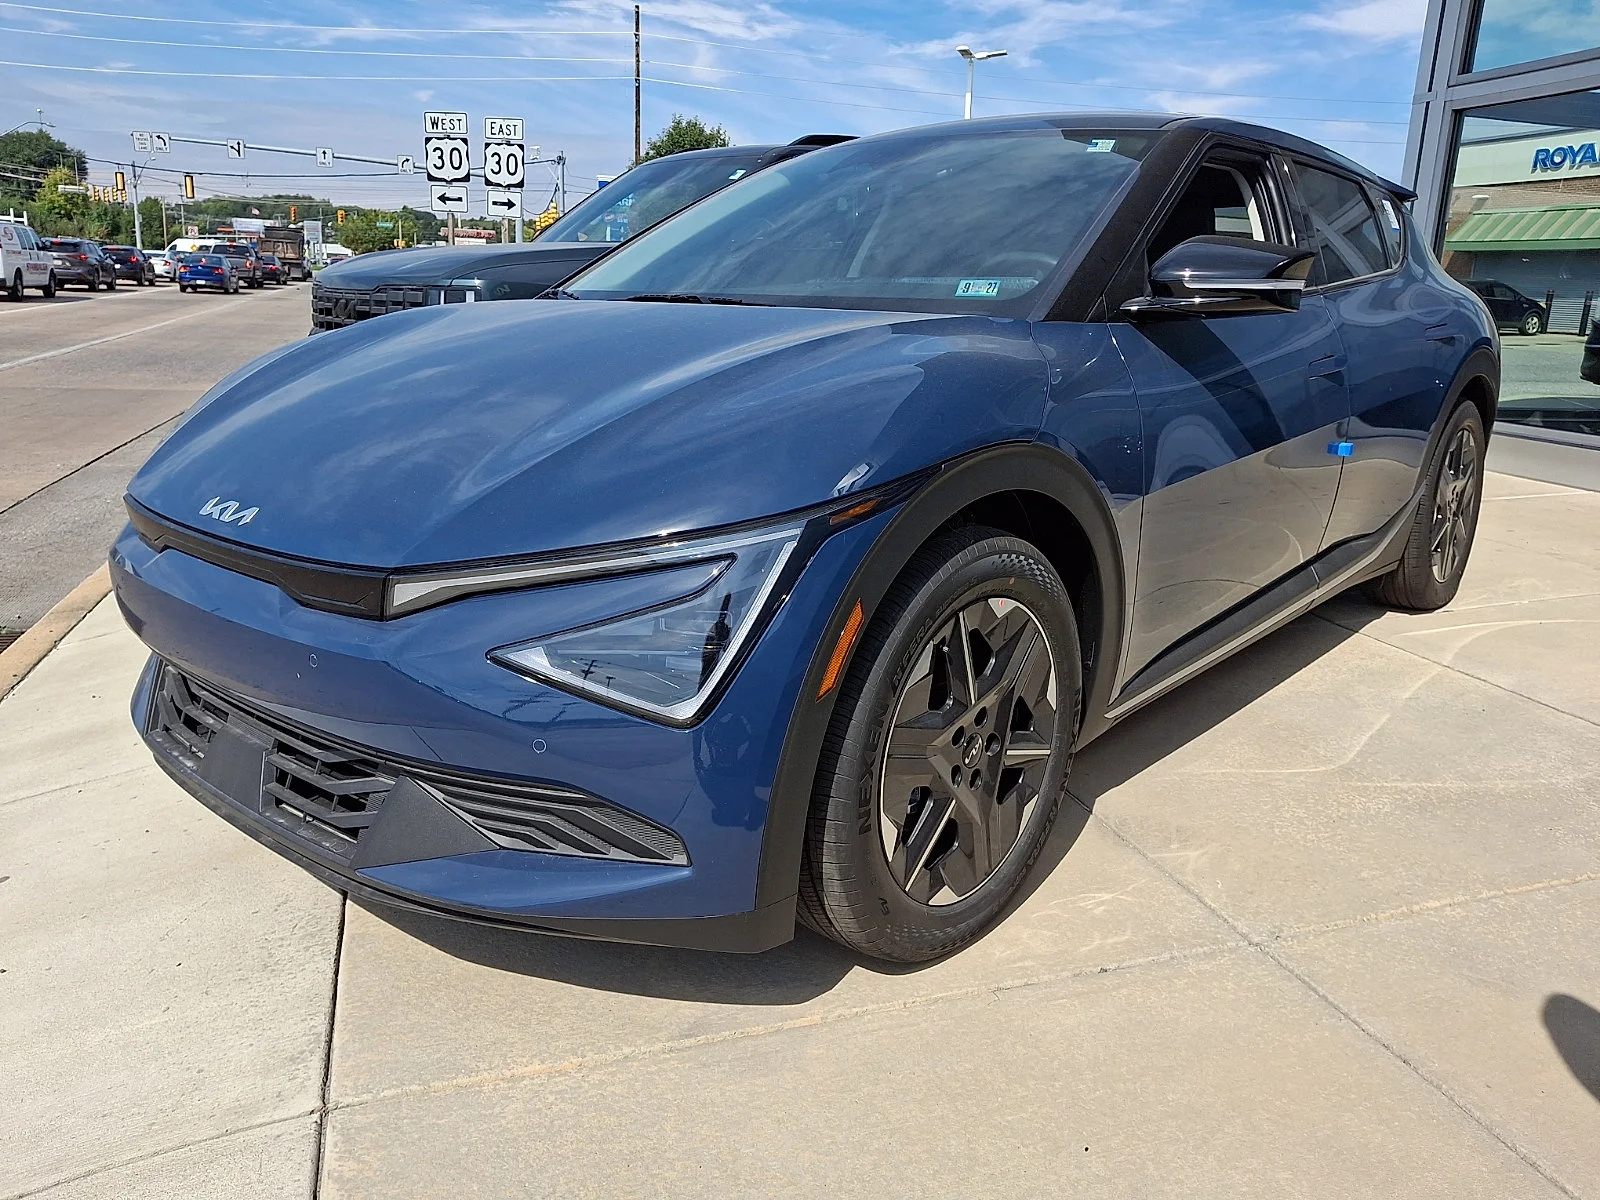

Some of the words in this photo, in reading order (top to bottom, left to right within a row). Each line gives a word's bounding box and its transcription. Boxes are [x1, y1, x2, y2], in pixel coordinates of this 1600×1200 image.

[429, 116, 462, 131] WEST
[490, 122, 518, 136] EAST
[432, 146, 463, 170] 30
[490, 152, 518, 176] 30
[1532, 142, 1600, 169] ROYA
[963, 282, 971, 294] 9
[985, 281, 998, 294] 27
[199, 496, 260, 526] KIA
[857, 698, 891, 837] NEXEN
